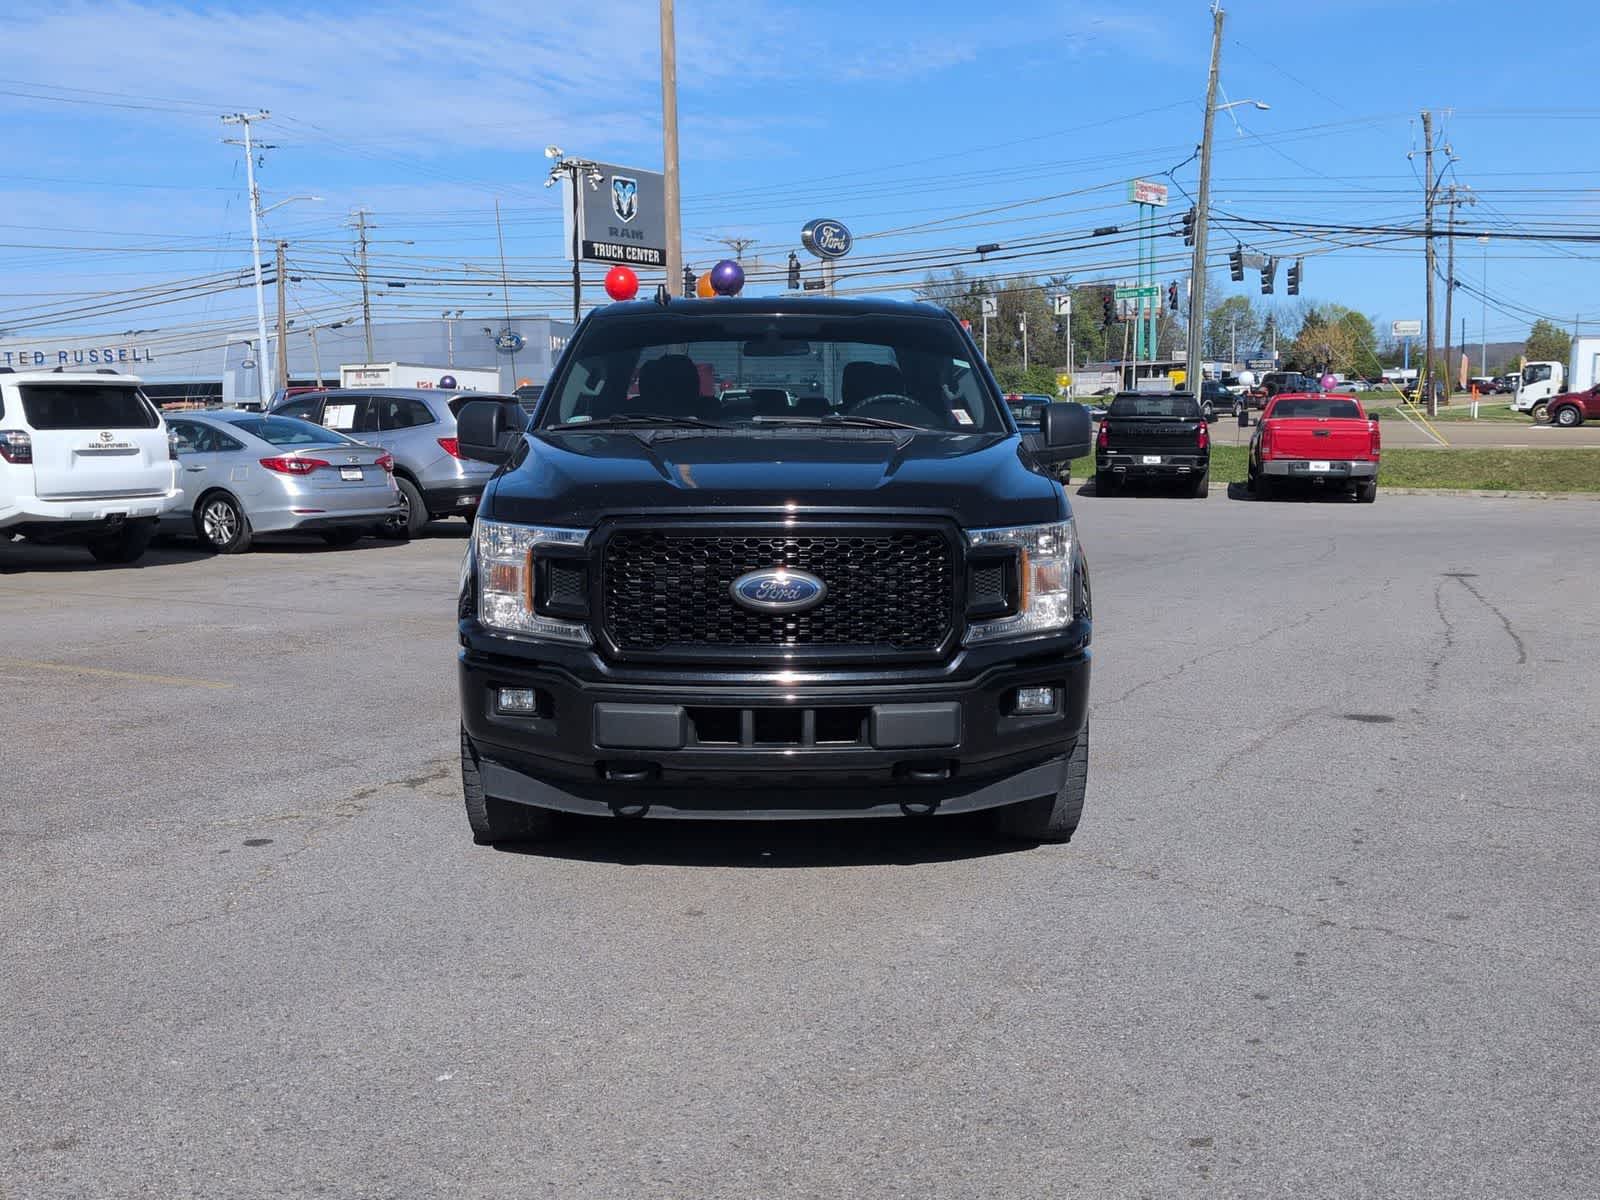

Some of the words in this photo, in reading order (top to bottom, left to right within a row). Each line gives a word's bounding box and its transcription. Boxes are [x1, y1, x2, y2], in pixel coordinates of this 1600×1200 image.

[608, 226, 644, 240] RAM
[820, 225, 846, 250] Ford
[592, 242, 625, 259] TRUCK
[625, 246, 660, 263] CENTER
[4, 351, 45, 365] TED
[58, 348, 155, 364] RUSSELL
[755, 579, 802, 600] Ford
